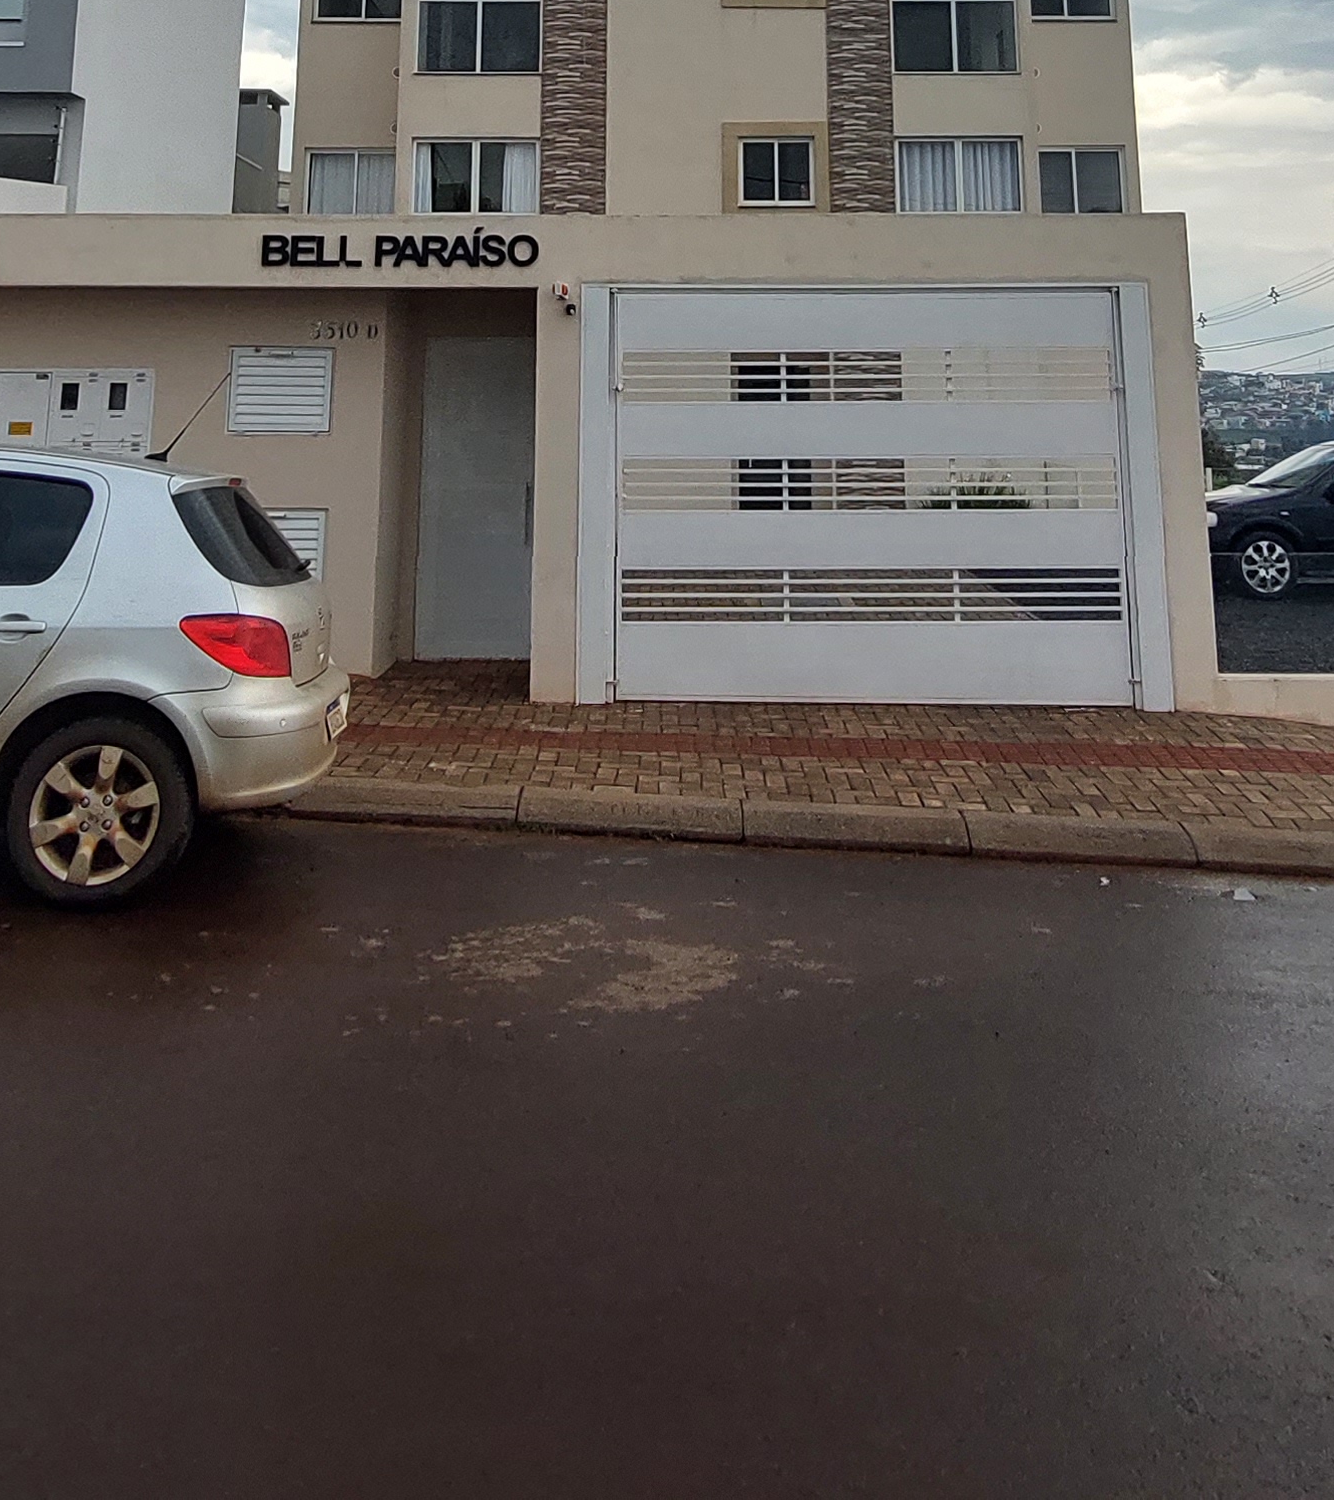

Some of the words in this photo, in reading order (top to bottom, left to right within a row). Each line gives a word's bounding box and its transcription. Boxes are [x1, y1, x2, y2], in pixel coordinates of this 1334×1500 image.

[261, 234, 362, 268] BELL
[374, 226, 540, 268] PARAÍSO
[309, 320, 358, 340] 3510
